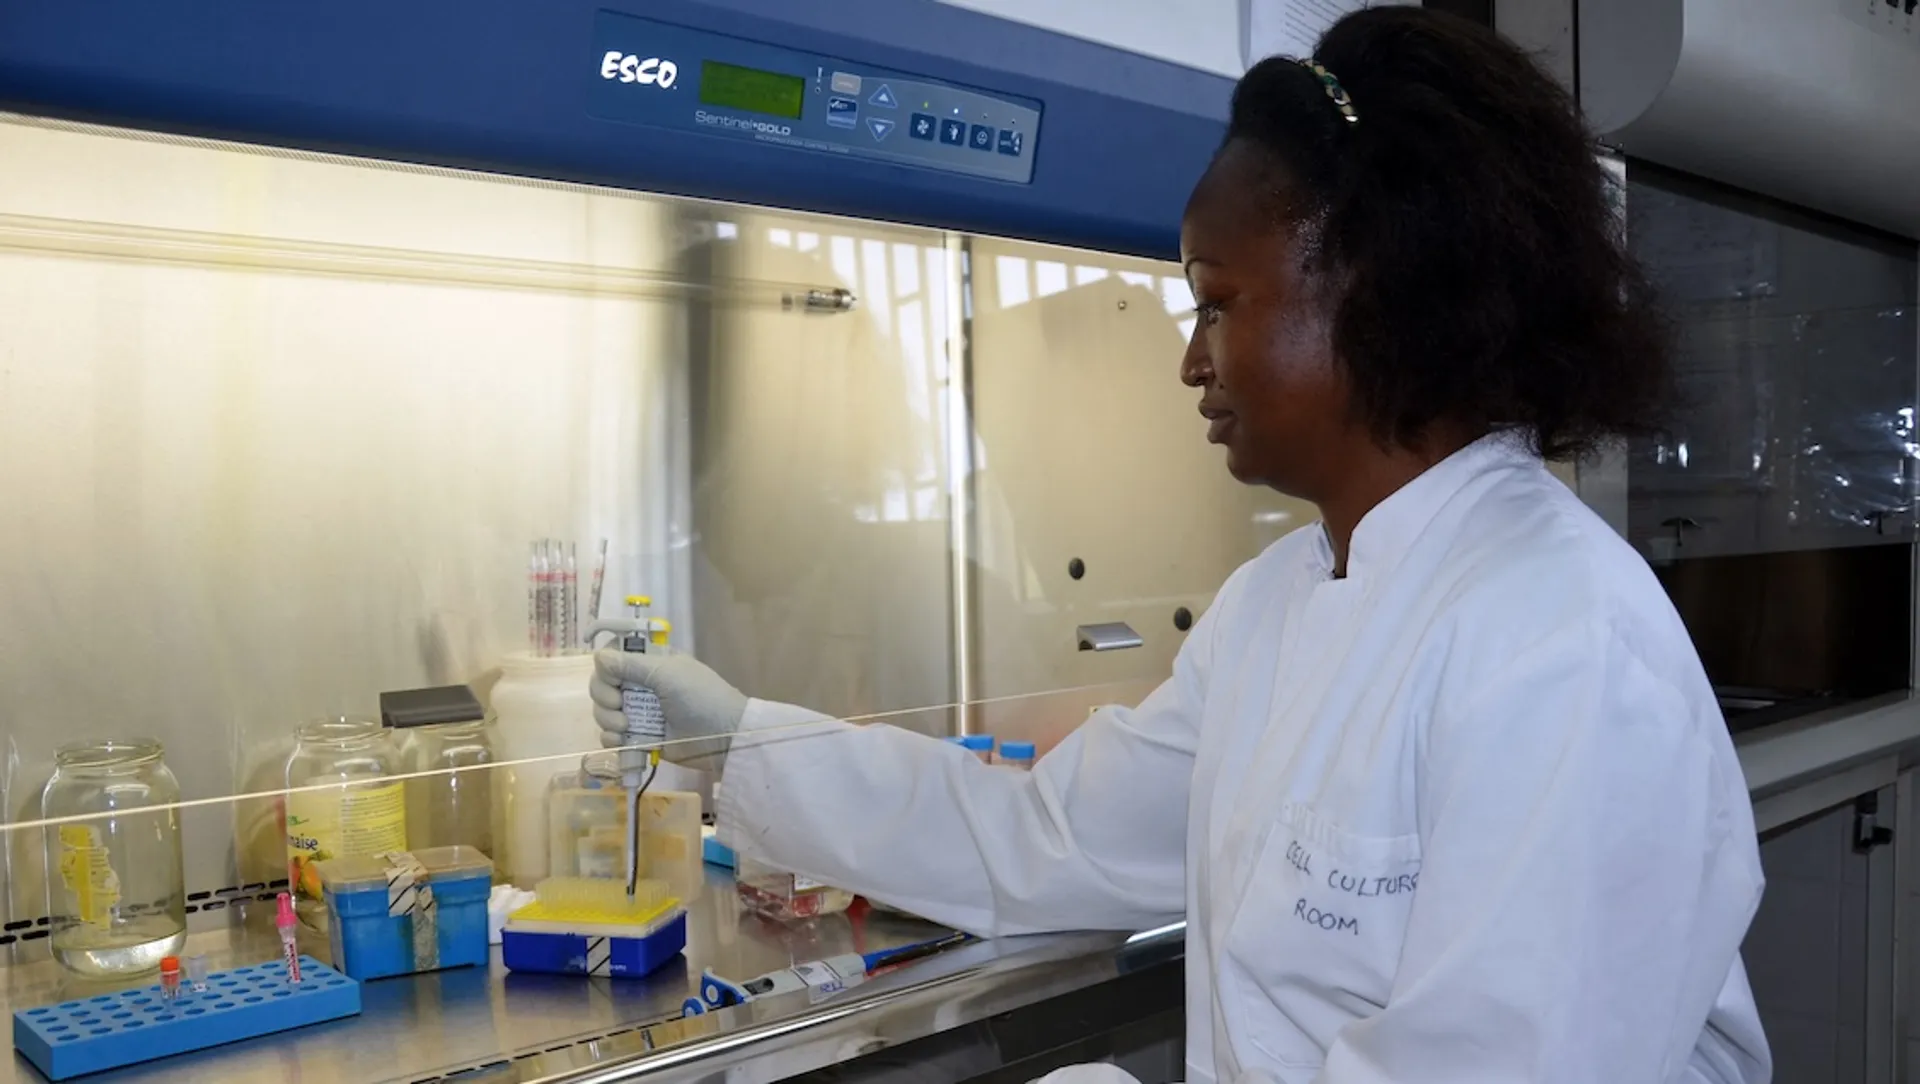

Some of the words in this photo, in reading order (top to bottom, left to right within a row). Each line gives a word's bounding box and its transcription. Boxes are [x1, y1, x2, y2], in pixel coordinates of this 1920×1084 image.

[601, 51, 677, 89] ESCO
[695, 110, 753, 130] Sentinel
[757, 122, 791, 137] GOLD
[1286, 840, 1311, 875] CELL
[1294, 898, 1359, 936] ROOM
